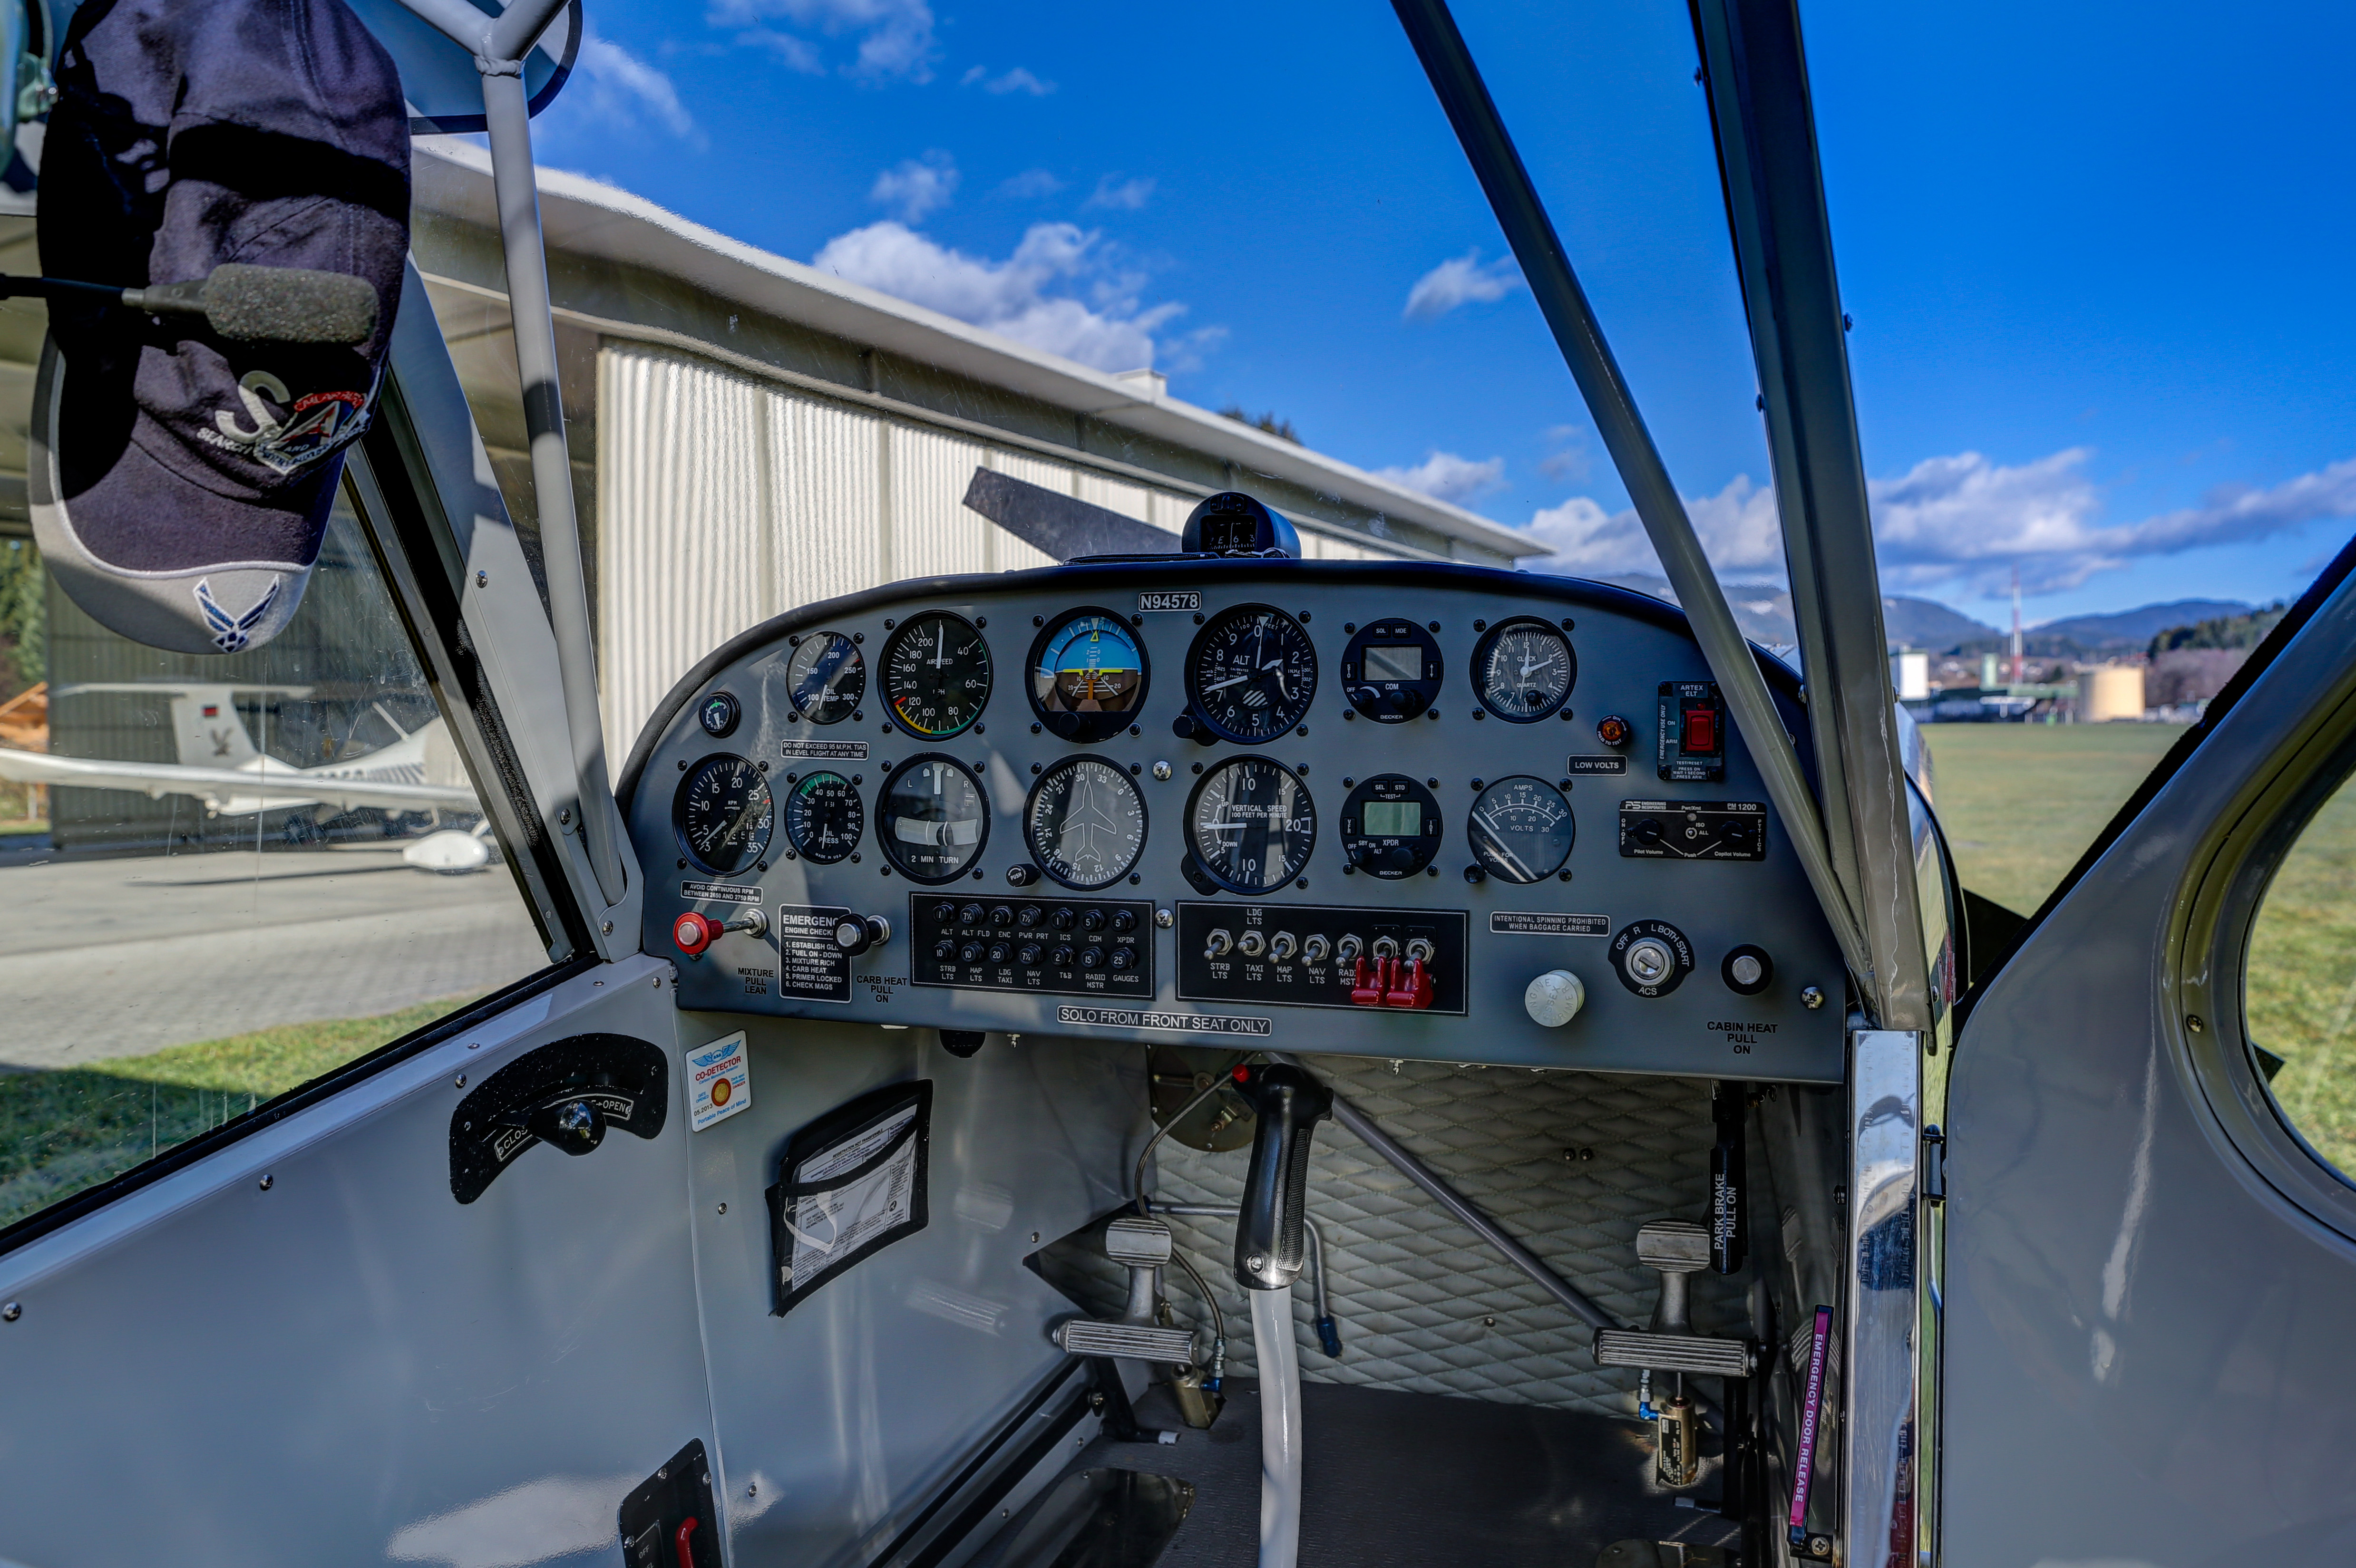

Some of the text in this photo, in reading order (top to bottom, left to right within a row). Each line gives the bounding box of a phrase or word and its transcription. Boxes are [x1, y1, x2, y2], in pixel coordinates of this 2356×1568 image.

[196, 427, 253, 454] SEARCH
[284, 444, 309, 452] AND
[1141, 594, 1197, 609] N94578
[918, 638, 933, 647] 200
[910, 650, 922, 659] 180
[958, 647, 968, 656] 40
[904, 664, 915, 672] 160
[965, 679, 976, 688] 60
[732, 777, 742, 788] 20
[1075, 774, 1085, 782] 30
[1098, 774, 1107, 784] 33
[749, 790, 759, 800] 25
[701, 801, 709, 811] 10
[1285, 819, 1301, 832] 20
[1011, 871, 1022, 881] PUSH
[707, 885, 740, 894] CONTINUOUS
[1634, 926, 1641, 935] R
[1651, 924, 1656, 932] L
[1658, 925, 1680, 942] BOTH
[1616, 934, 1629, 950] OFF
[1676, 941, 1690, 967] START
[738, 968, 774, 978] MIXTURE
[745, 977, 766, 986] PULL
[857, 975, 907, 986] CARB HEAT
[745, 985, 768, 995] LEAN
[871, 985, 894, 994] PULL
[1639, 986, 1657, 995] ACS
[876, 995, 888, 1003] ON
[1061, 1008, 1267, 1033] SOLO FROM FRONT SEAT ONLY
[1707, 1022, 1778, 1033] CABIN HEAT
[1727, 1034, 1757, 1043] PULL
[1733, 1045, 1751, 1054] ON
[695, 1055, 741, 1081] CO-DETECTOR
[733, 1081, 746, 1089] DANGER
[603, 1100, 625, 1112] OPEN
[694, 1103, 713, 1116] 05.2013
[698, 1113, 716, 1125] Portable
[717, 1106, 730, 1116] Peace
[736, 1098, 746, 1107] Mind
[1714, 1173, 1724, 1250] PARK BRAKE
[1725, 1187, 1737, 1238] PULL ON
[1795, 1333, 1823, 1503] EMERGENCY DOOR RELEASE
